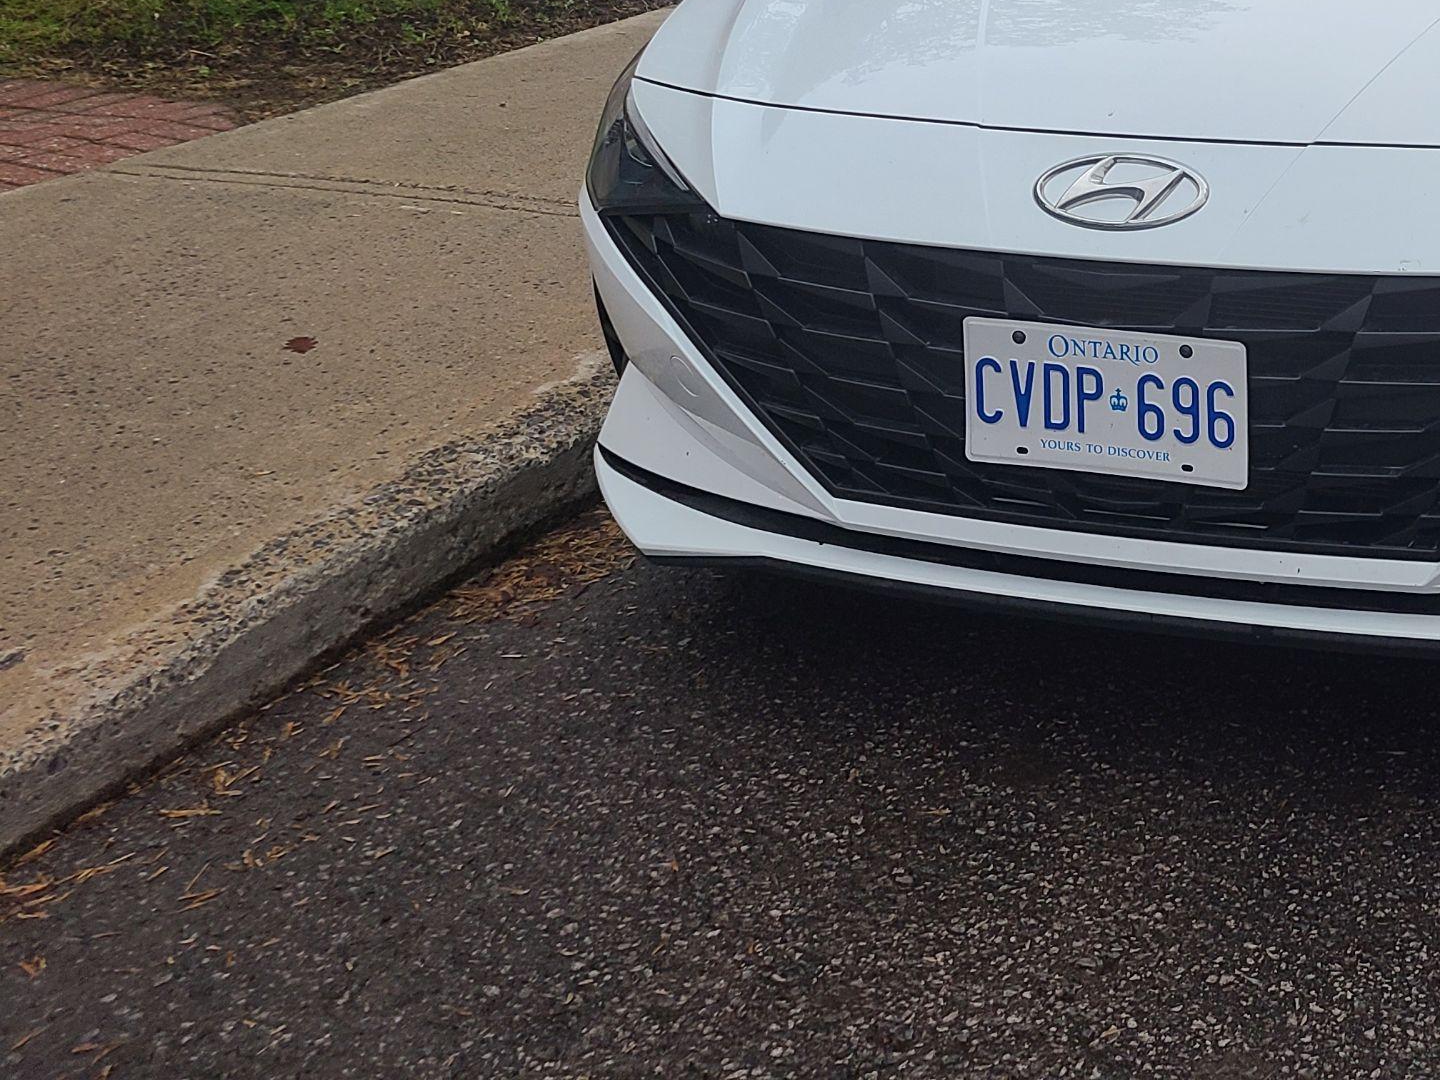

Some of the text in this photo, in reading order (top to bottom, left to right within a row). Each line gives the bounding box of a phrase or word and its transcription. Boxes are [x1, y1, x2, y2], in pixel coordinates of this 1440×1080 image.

[1048, 334, 1159, 366] ONTARIO
[975, 357, 1235, 449] CVDP 696
[1040, 438, 1170, 462] YOURS TO DISCOVER
